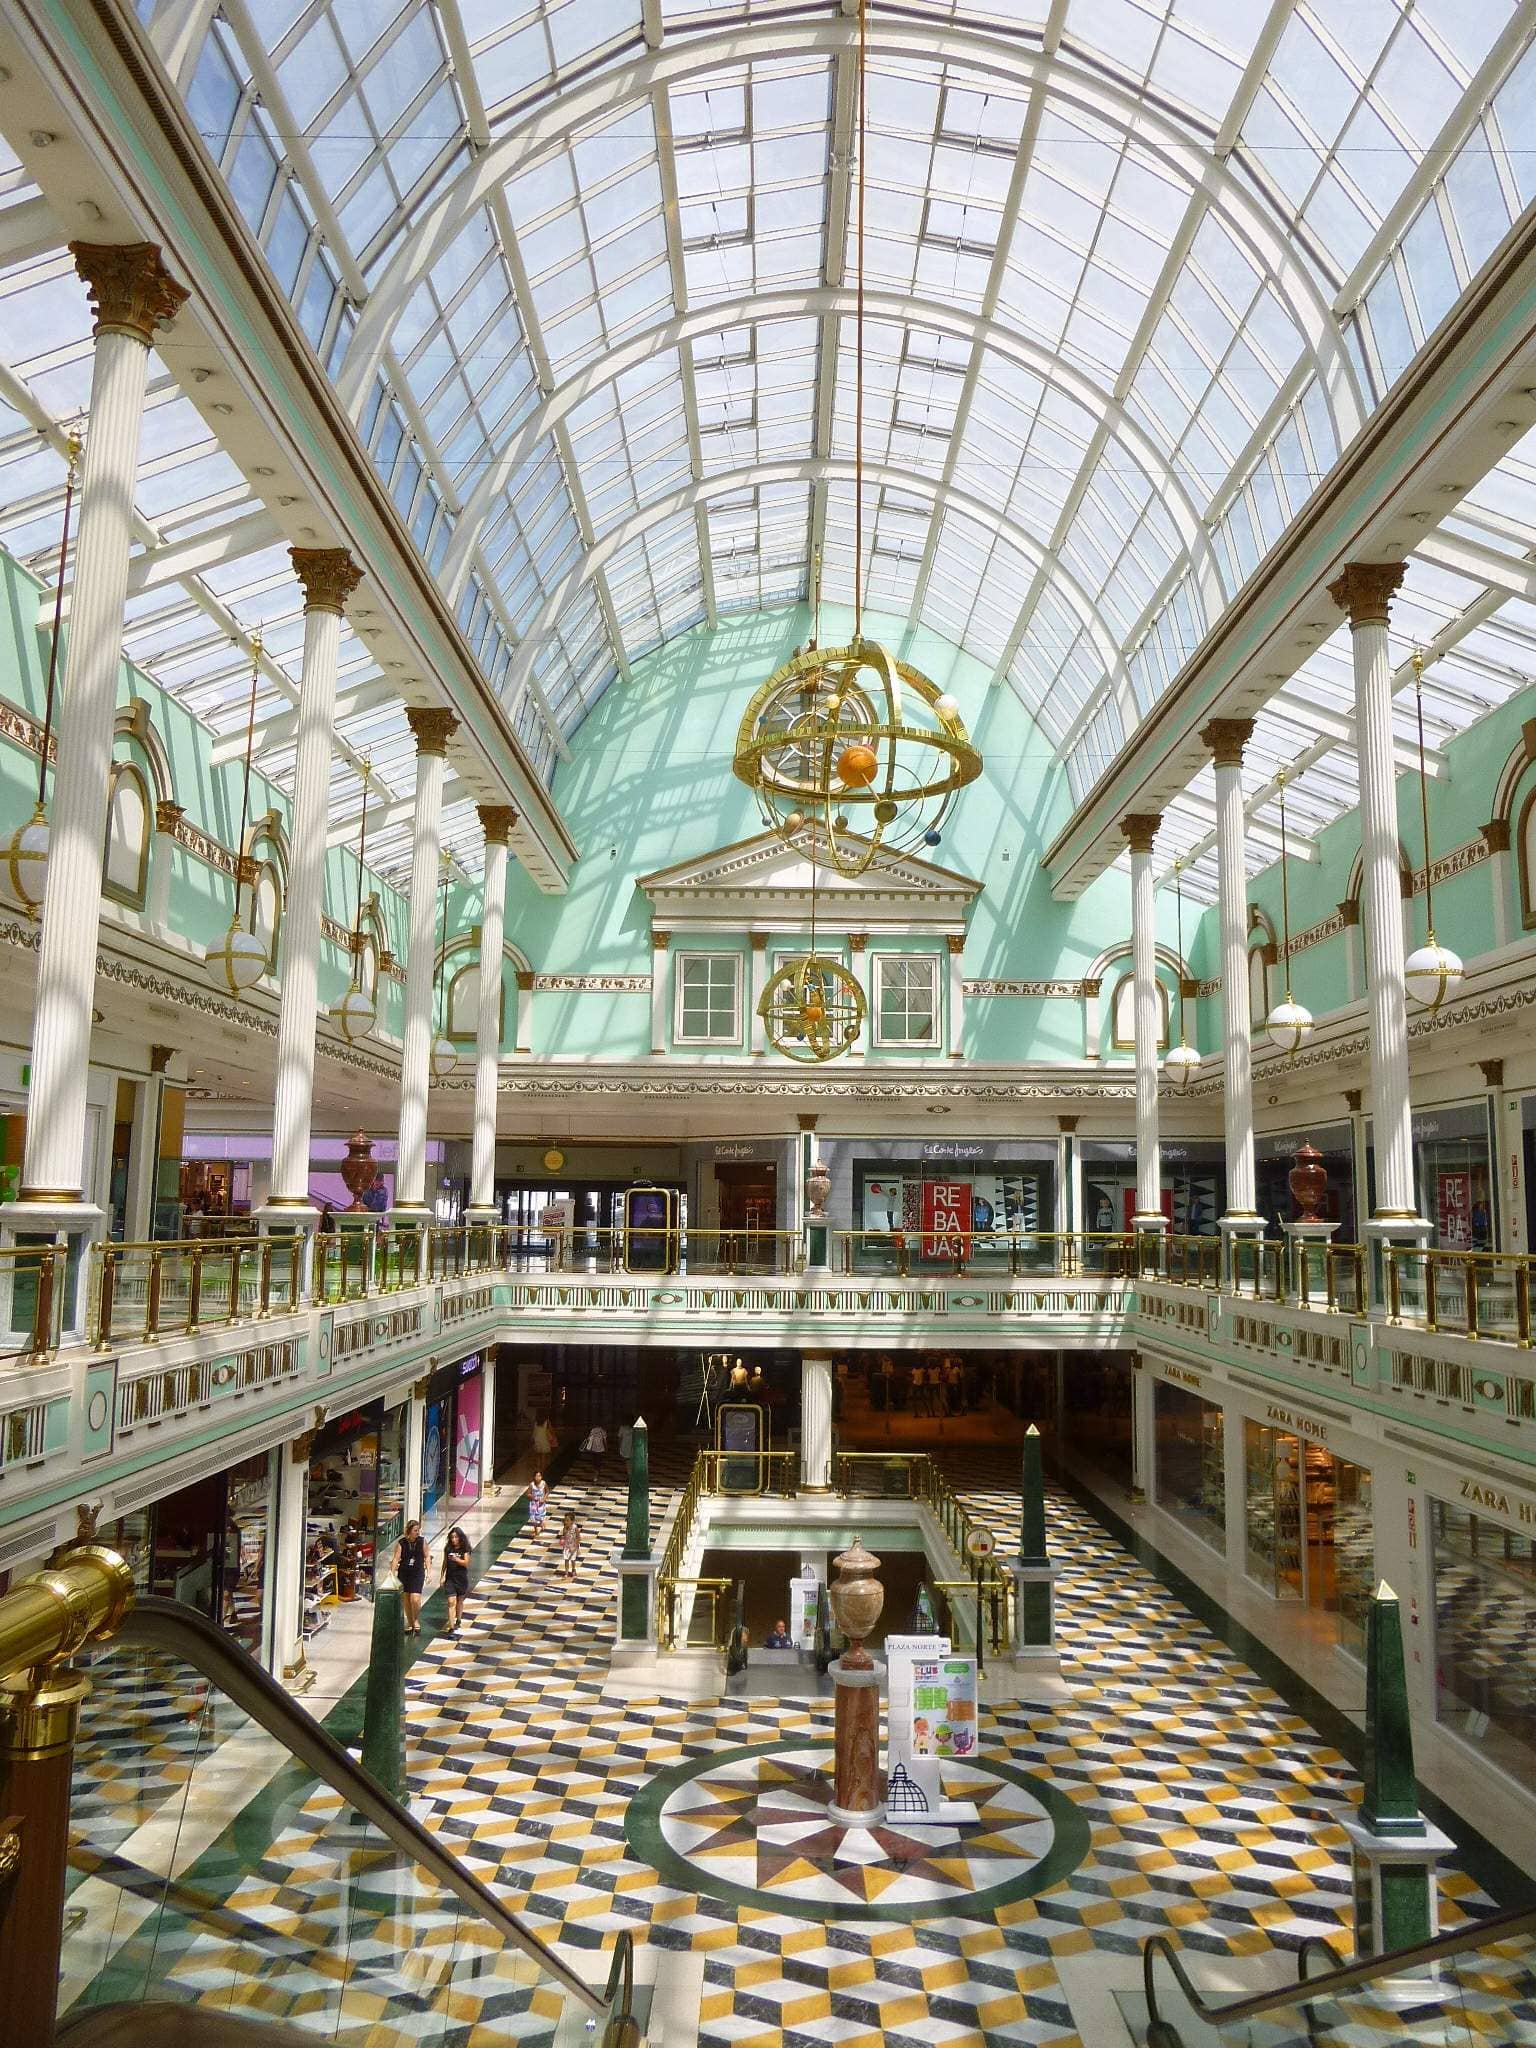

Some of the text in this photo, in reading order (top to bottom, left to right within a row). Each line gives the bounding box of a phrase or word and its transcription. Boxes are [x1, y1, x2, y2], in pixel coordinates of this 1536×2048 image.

[923, 1145, 933, 1154] El
[933, 1144, 954, 1154] Corte
[933, 1185, 961, 1207] RE
[1445, 1178, 1464, 1208] RE
[934, 1210, 961, 1232] BA
[1266, 1404, 1328, 1440] ZARA HOME
[1459, 1479, 1511, 1515] ZARA
